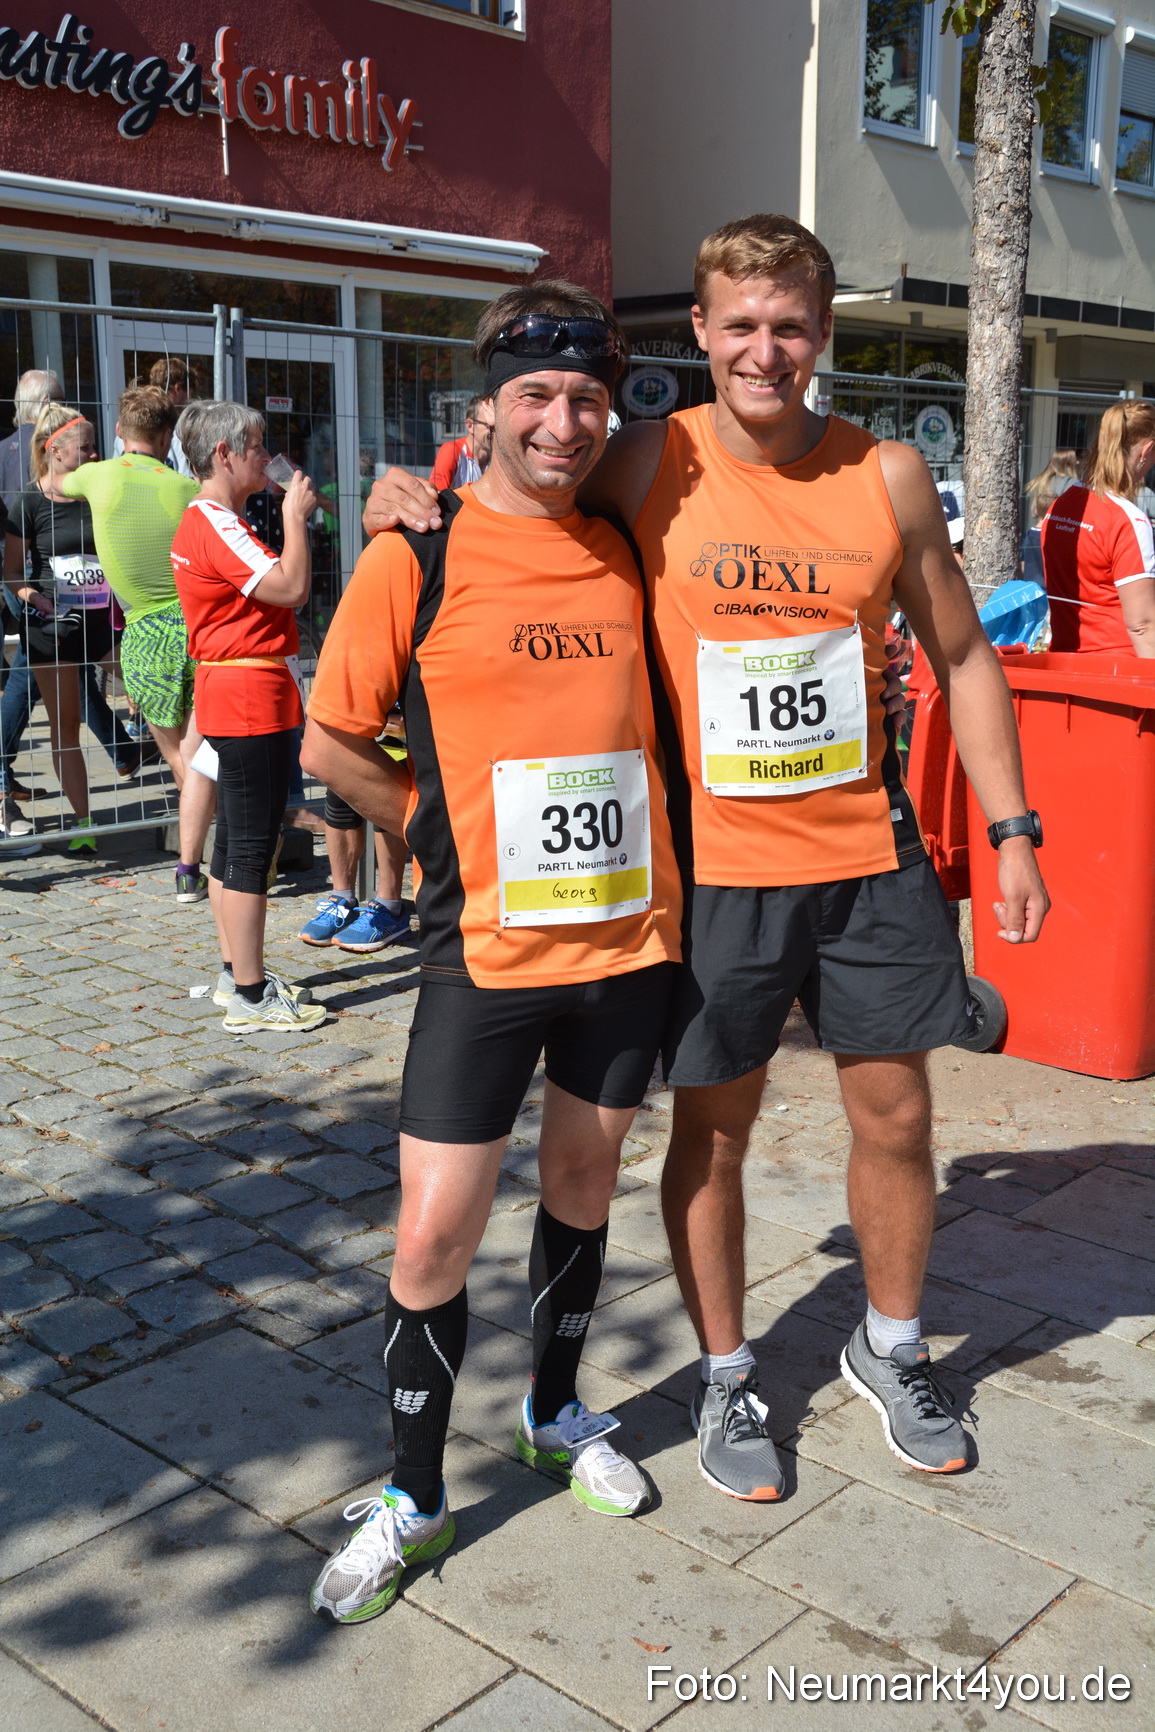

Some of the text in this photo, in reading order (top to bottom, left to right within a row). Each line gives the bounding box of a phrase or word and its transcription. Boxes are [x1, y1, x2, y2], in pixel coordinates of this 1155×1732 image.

[212, 26, 418, 172] family
[873, 412, 893, 426] Tees
[764, 548, 799, 559] UHREN
[802, 550, 823, 560] UND
[825, 552, 873, 564] SCHMUCK
[63, 568, 105, 586] 2038
[713, 558, 831, 595] OEXL
[561, 623, 588, 632] UHREN
[589, 621, 605, 630] UND
[527, 632, 614, 661] OEXL
[744, 649, 817, 673] BOCK
[794, 665, 818, 676] concepts
[739, 678, 827, 732] 185
[709, 721, 716, 731] A
[737, 734, 821, 749] PARTL Neumarkt
[749, 753, 824, 779] Richard
[547, 767, 616, 791] BOCK
[547, 788, 571, 797] inspired
[595, 785, 617, 793] concepts
[541, 799, 623, 854] 330
[508, 847, 515, 857] C
[537, 856, 618, 872] PARTL Neumarkt
[552, 882, 598, 903] Georg
[555, 1328, 584, 1339] cep
[392, 1401, 422, 1414] cep
